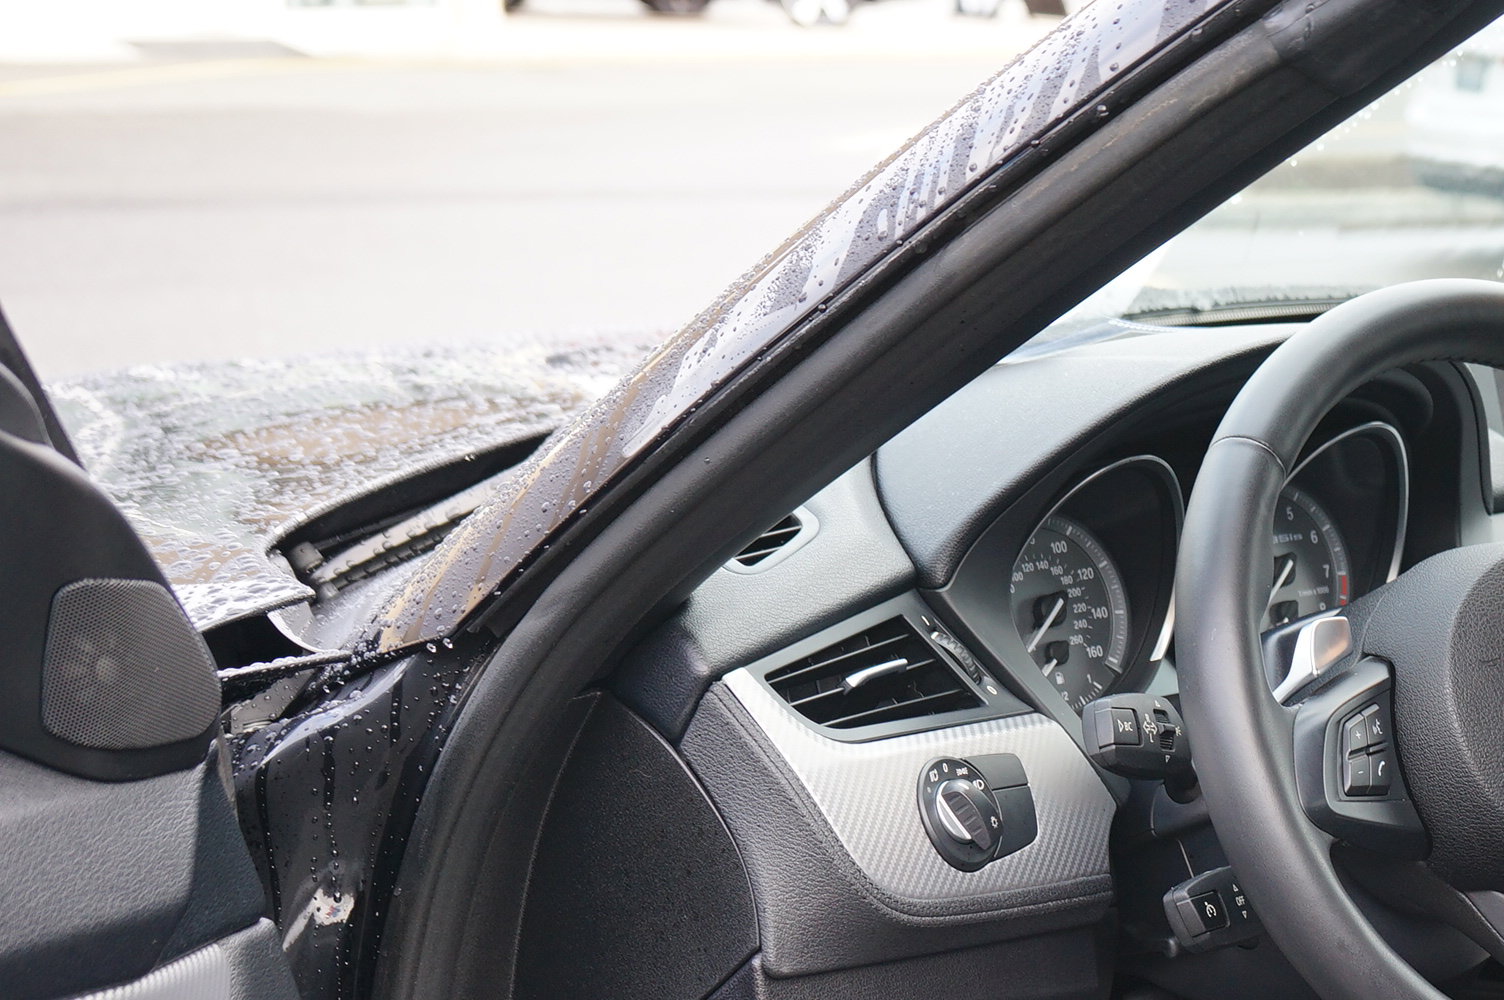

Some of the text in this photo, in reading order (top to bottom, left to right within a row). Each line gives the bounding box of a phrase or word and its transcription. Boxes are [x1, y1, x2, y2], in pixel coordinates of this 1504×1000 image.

[1286, 506, 1294, 521] 5
[1310, 529, 1319, 545] 6
[1051, 541, 1067, 553] 100
[1022, 562, 1035, 573] 120
[1036, 560, 1049, 570] 140
[1050, 565, 1064, 576] 160
[1078, 568, 1094, 580] 120
[1322, 564, 1330, 579] 7
[1061, 575, 1074, 585] 180
[1068, 587, 1082, 598] 200
[1073, 602, 1087, 613] 220
[1091, 607, 1108, 619] 140
[1073, 618, 1088, 629] 240
[1070, 633, 1084, 645] 260
[1087, 645, 1103, 658] 160
[1087, 674, 1092, 683] 1
